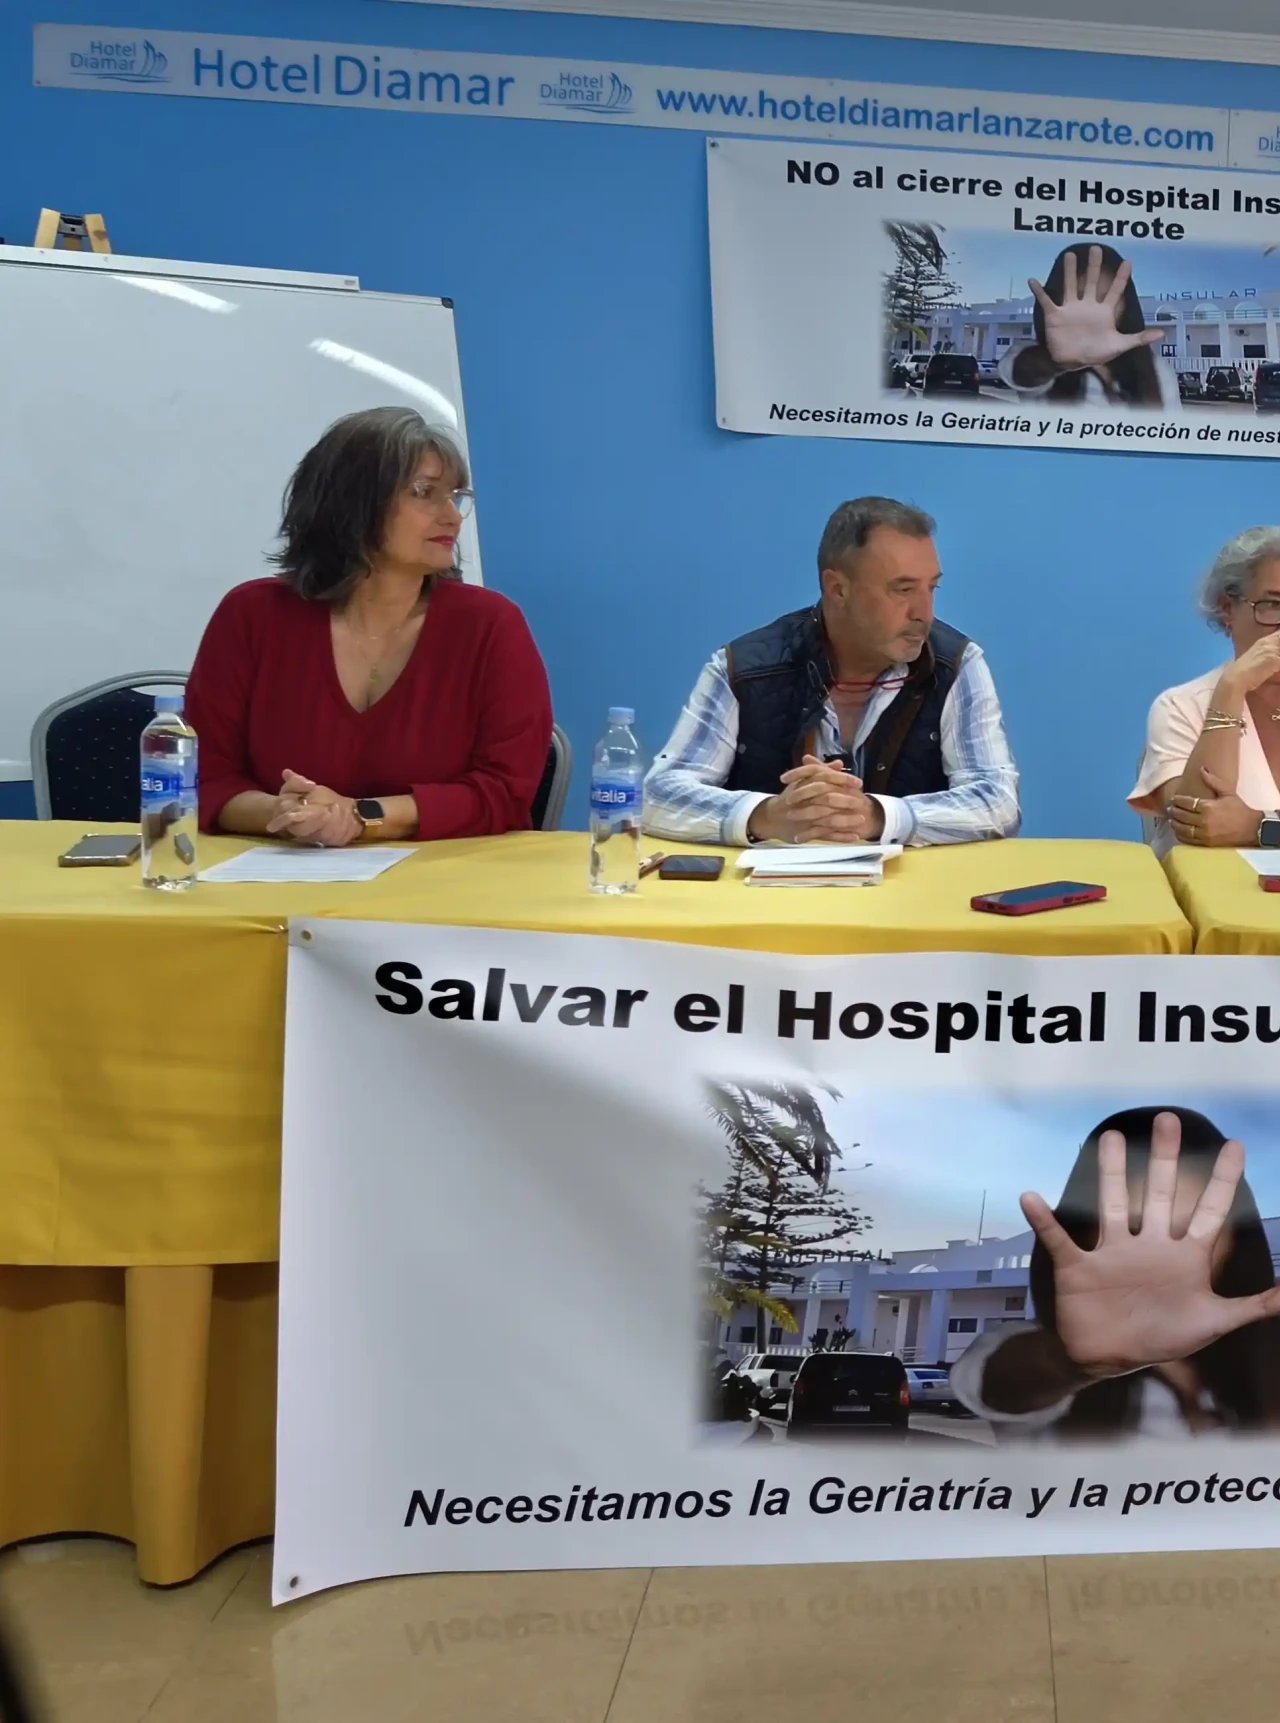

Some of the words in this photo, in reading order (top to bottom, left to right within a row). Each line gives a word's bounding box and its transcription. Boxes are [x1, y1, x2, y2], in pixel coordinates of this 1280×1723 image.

[70, 52, 136, 70] Diamar
[90, 41, 136, 57] Hotel
[194, 47, 320, 95] Hotel
[335, 56, 515, 107] Diamar
[540, 83, 604, 102] Diamar
[560, 72, 604, 89] Hotel
[656, 85, 1214, 152] www.hoteldiamarlanzarote.com
[787, 159, 840, 186] NO
[852, 165, 884, 190] al
[896, 169, 1003, 198] cierre
[1014, 176, 1066, 202] del
[1078, 180, 1220, 214] Hospital
[1013, 207, 1185, 241] Lanzarote
[1159, 288, 1257, 301] INSULAR
[769, 403, 909, 427] Necesitamos
[916, 411, 934, 427] la
[941, 412, 1031, 433] Geriatría
[1036, 421, 1051, 437] y
[1056, 418, 1074, 434] la
[1079, 421, 1191, 440] protección
[1196, 425, 1222, 442] de
[375, 961, 649, 1029] Salvar
[673, 984, 745, 1034] el
[777, 989, 1106, 1054] Hospital
[403, 1484, 733, 1528] Necesitamos
[748, 1479, 791, 1516] la
[809, 1476, 1013, 1515] Geriatría
[1025, 1487, 1058, 1519] y
[1069, 1477, 1109, 1508] la
